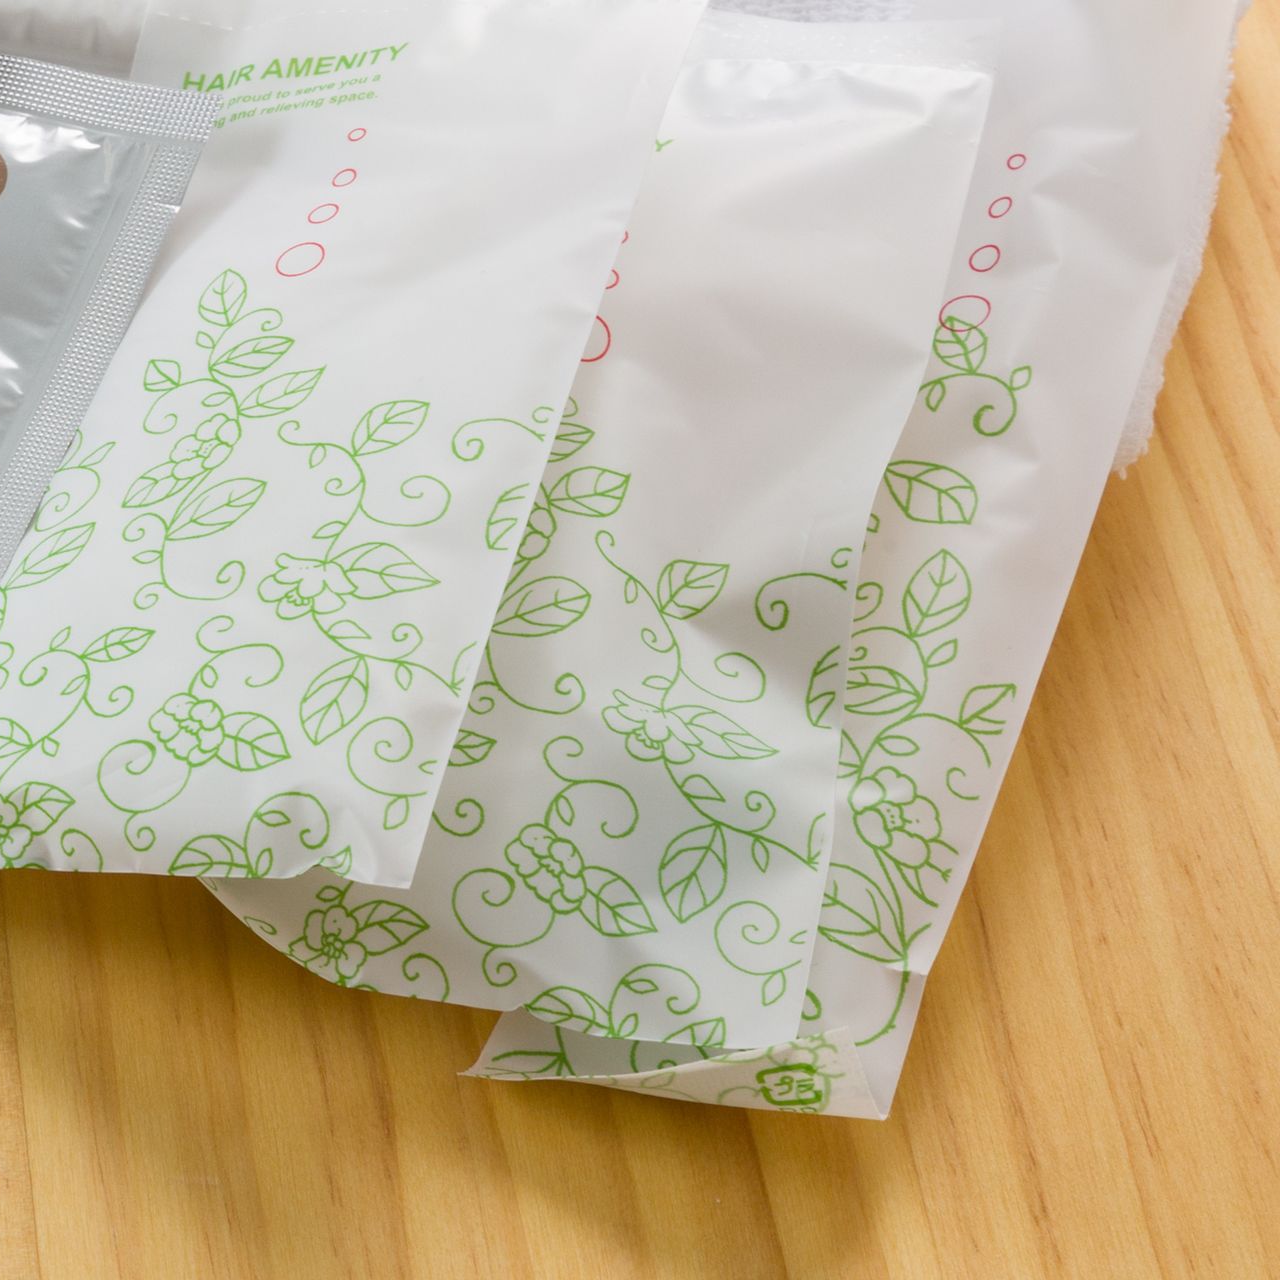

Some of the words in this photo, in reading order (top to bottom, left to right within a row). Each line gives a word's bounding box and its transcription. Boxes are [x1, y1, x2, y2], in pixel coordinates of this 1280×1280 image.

[182, 64, 255, 93] HAIR
[260, 42, 408, 80] AMENITY
[223, 92, 271, 110] proud
[276, 90, 290, 100] to
[295, 81, 335, 96] serve
[339, 77, 368, 91] you
[371, 74, 381, 82] a
[230, 107, 256, 122] and
[260, 96, 324, 116] relieving
